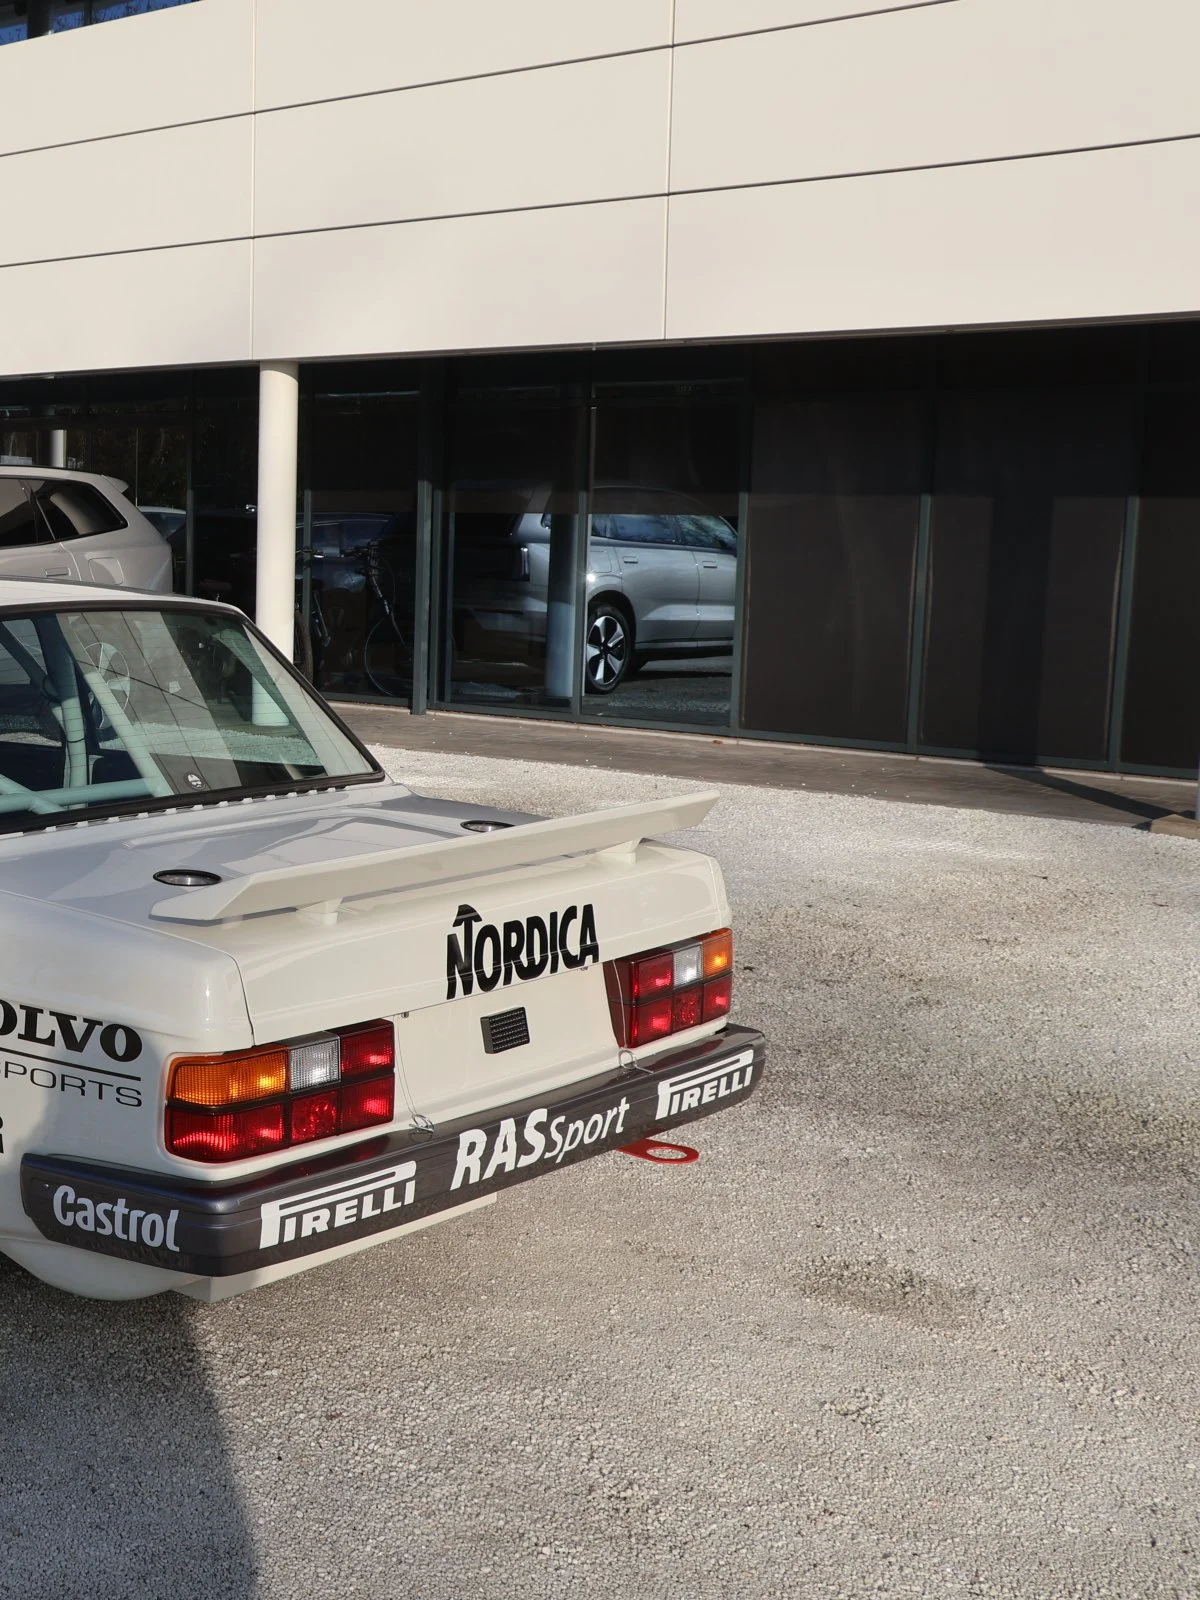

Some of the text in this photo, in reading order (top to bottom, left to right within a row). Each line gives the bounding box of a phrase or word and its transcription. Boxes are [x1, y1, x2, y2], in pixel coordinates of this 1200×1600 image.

[446, 903, 599, 1000] NORDICA
[655, 1049, 754, 1121] PIRELLI
[53, 1184, 180, 1252] Castrol
[259, 1160, 417, 1250] PIRELLI
